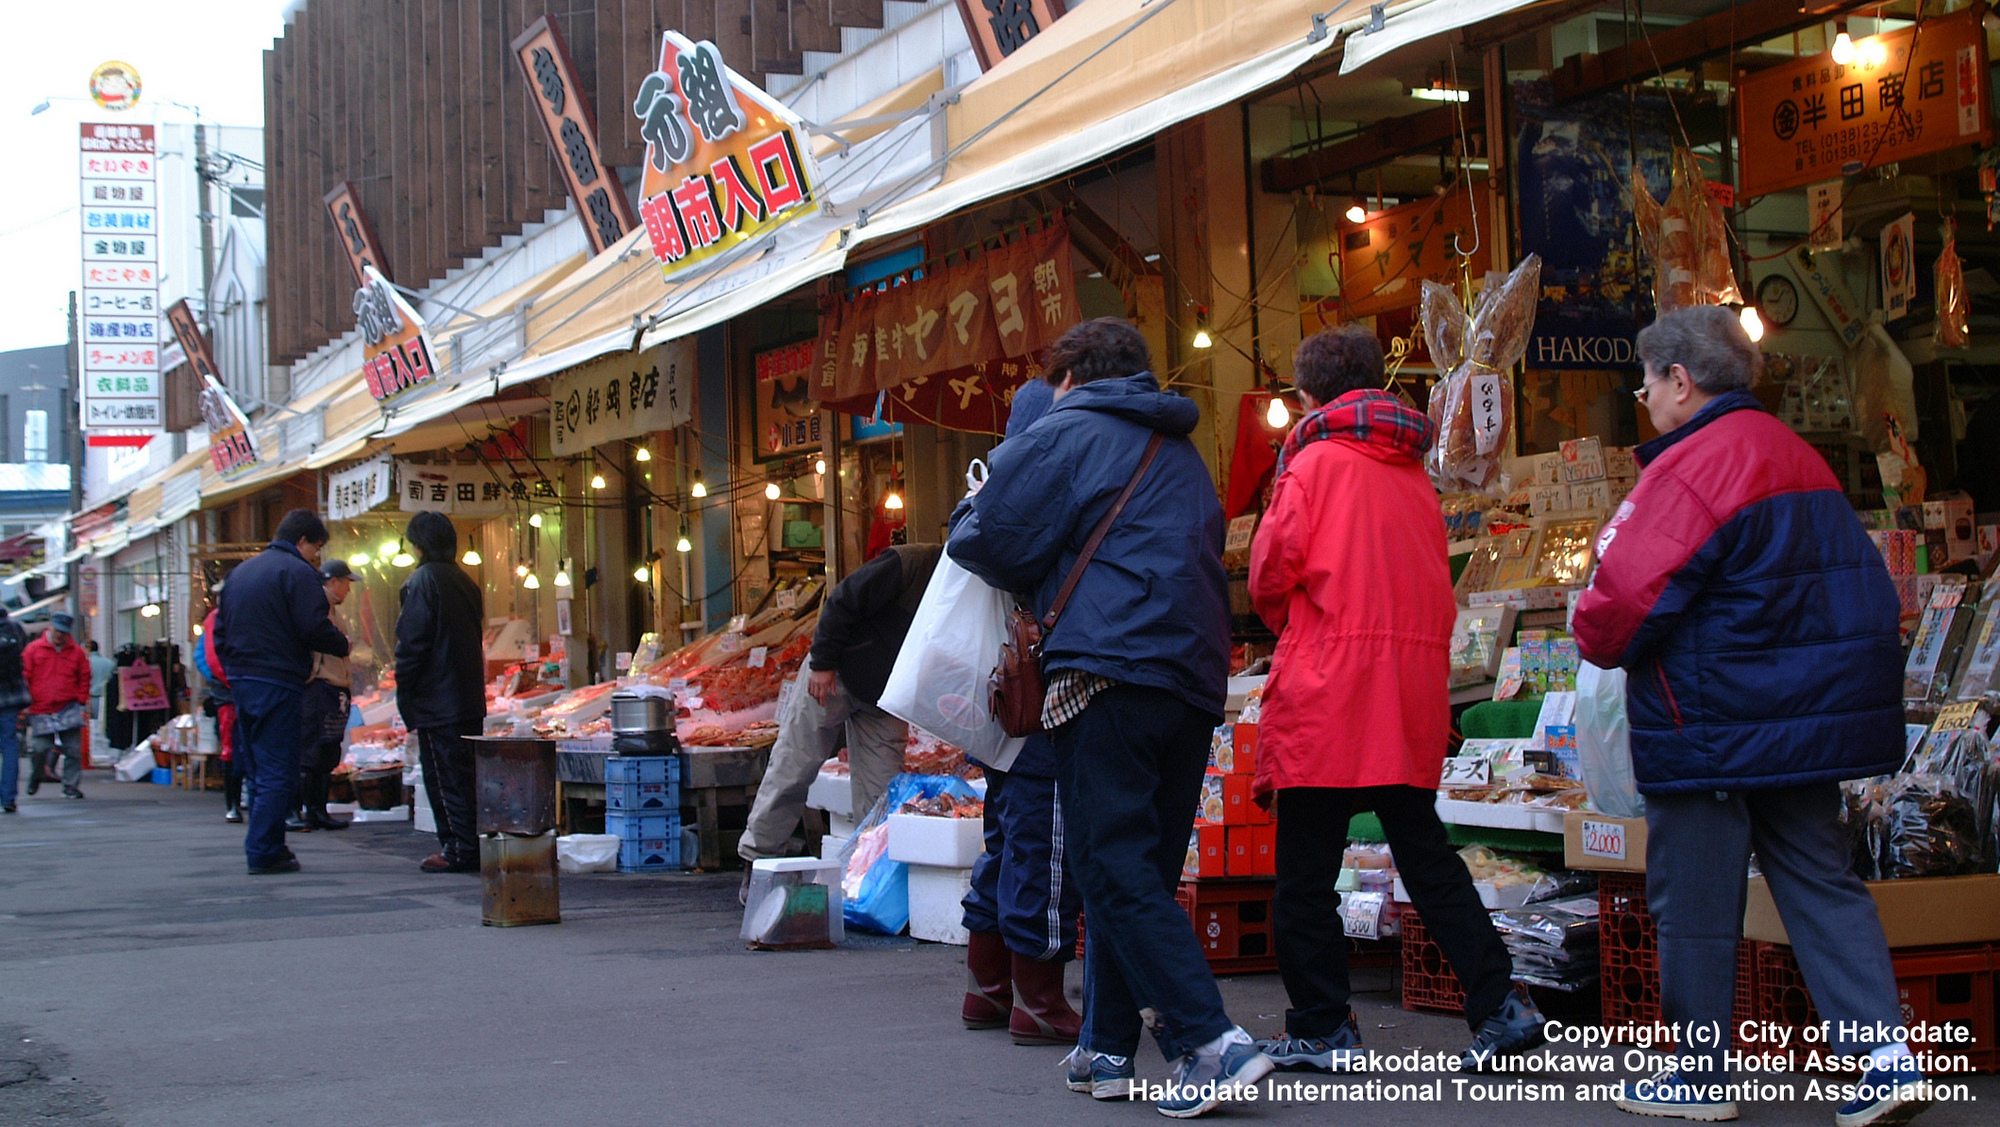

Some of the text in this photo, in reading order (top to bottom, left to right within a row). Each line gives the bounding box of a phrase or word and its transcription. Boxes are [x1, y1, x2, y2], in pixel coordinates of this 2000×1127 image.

[1803, 60, 1945, 130] 半田商店
[635, 40, 746, 173] 元祖
[1795, 137, 1816, 154] TEL
[88, 159, 149, 173] たいやき
[639, 131, 809, 265] 朝市入口
[94, 240, 145, 255] 金物屋
[89, 268, 151, 282] たこやき
[1034, 258, 1063, 327] 朝市
[89, 296, 153, 310] コーヒー店
[89, 321, 153, 338] 海産物店
[90, 349, 155, 365] ラーメン店
[97, 376, 149, 392] 衣料品
[1443, 758, 1488, 781] チーズ
